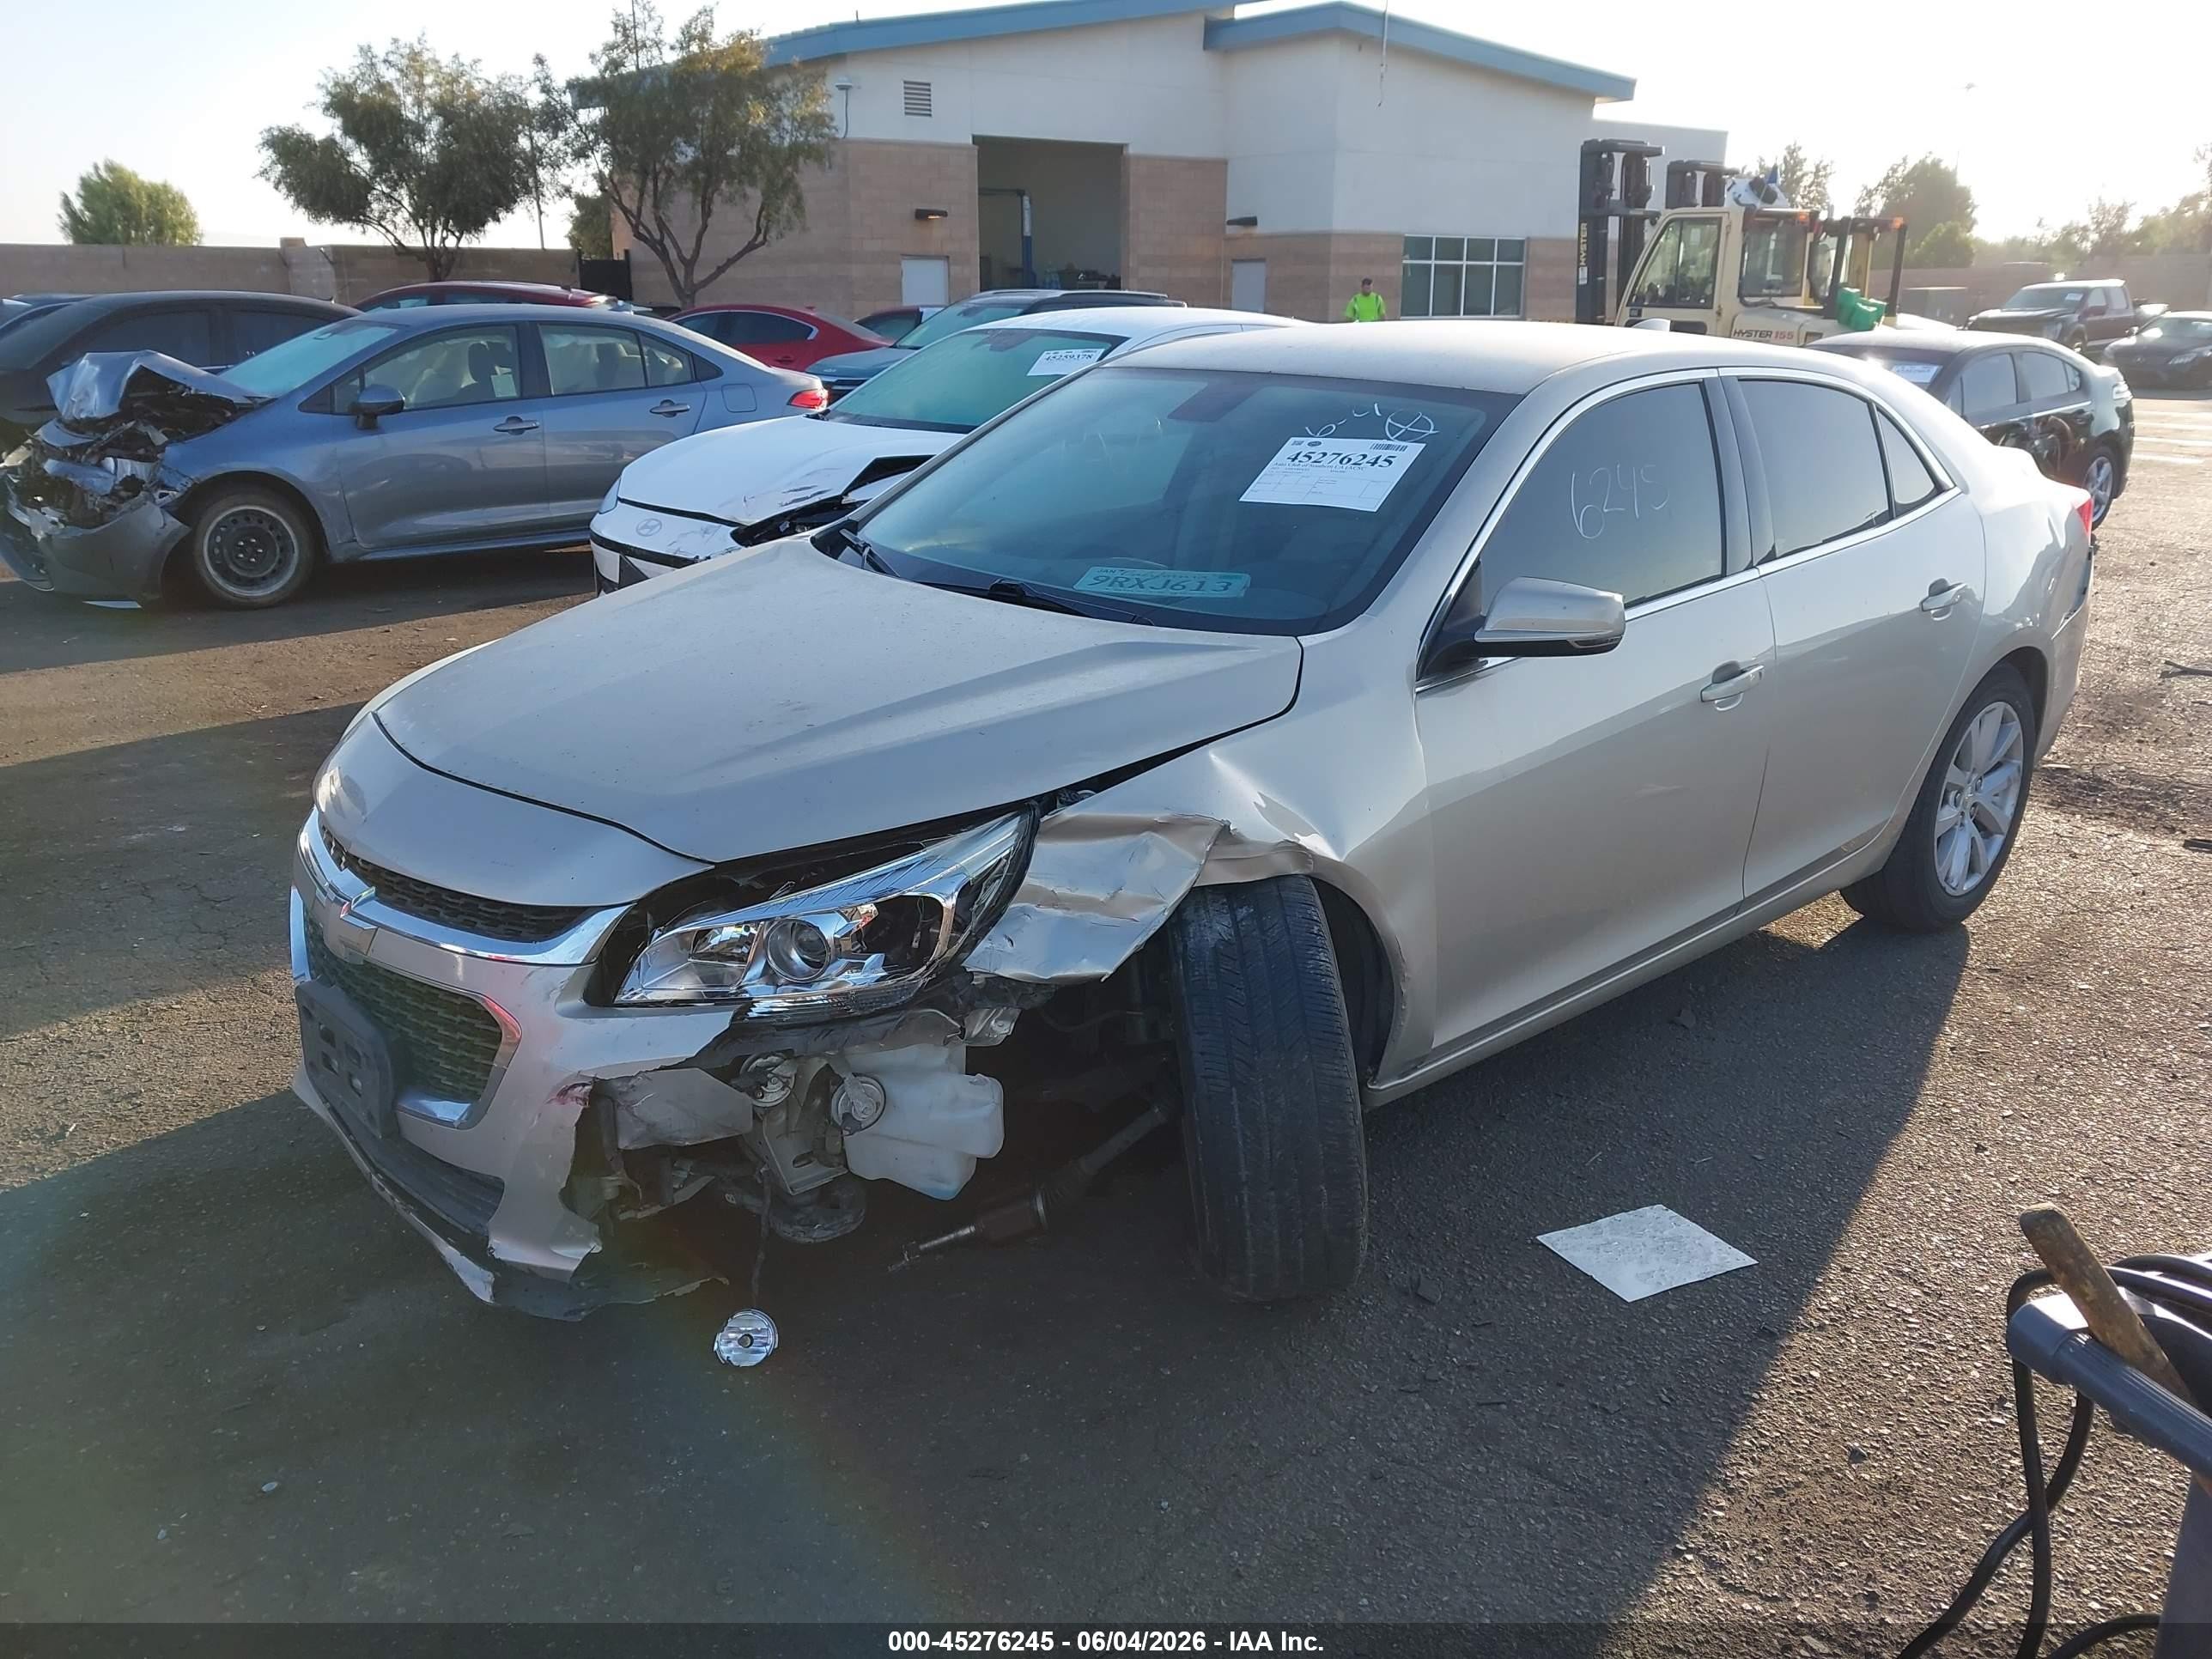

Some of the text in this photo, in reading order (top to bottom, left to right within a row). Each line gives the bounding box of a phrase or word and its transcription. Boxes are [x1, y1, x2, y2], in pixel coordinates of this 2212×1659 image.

[1579, 222, 1588, 265] HYSTER
[1732, 329, 1794, 340] HYSTER 155
[1286, 451, 1398, 468] 45276245
[1571, 460, 1670, 539] 6245
[1087, 575, 1232, 592] 9RXJ613
